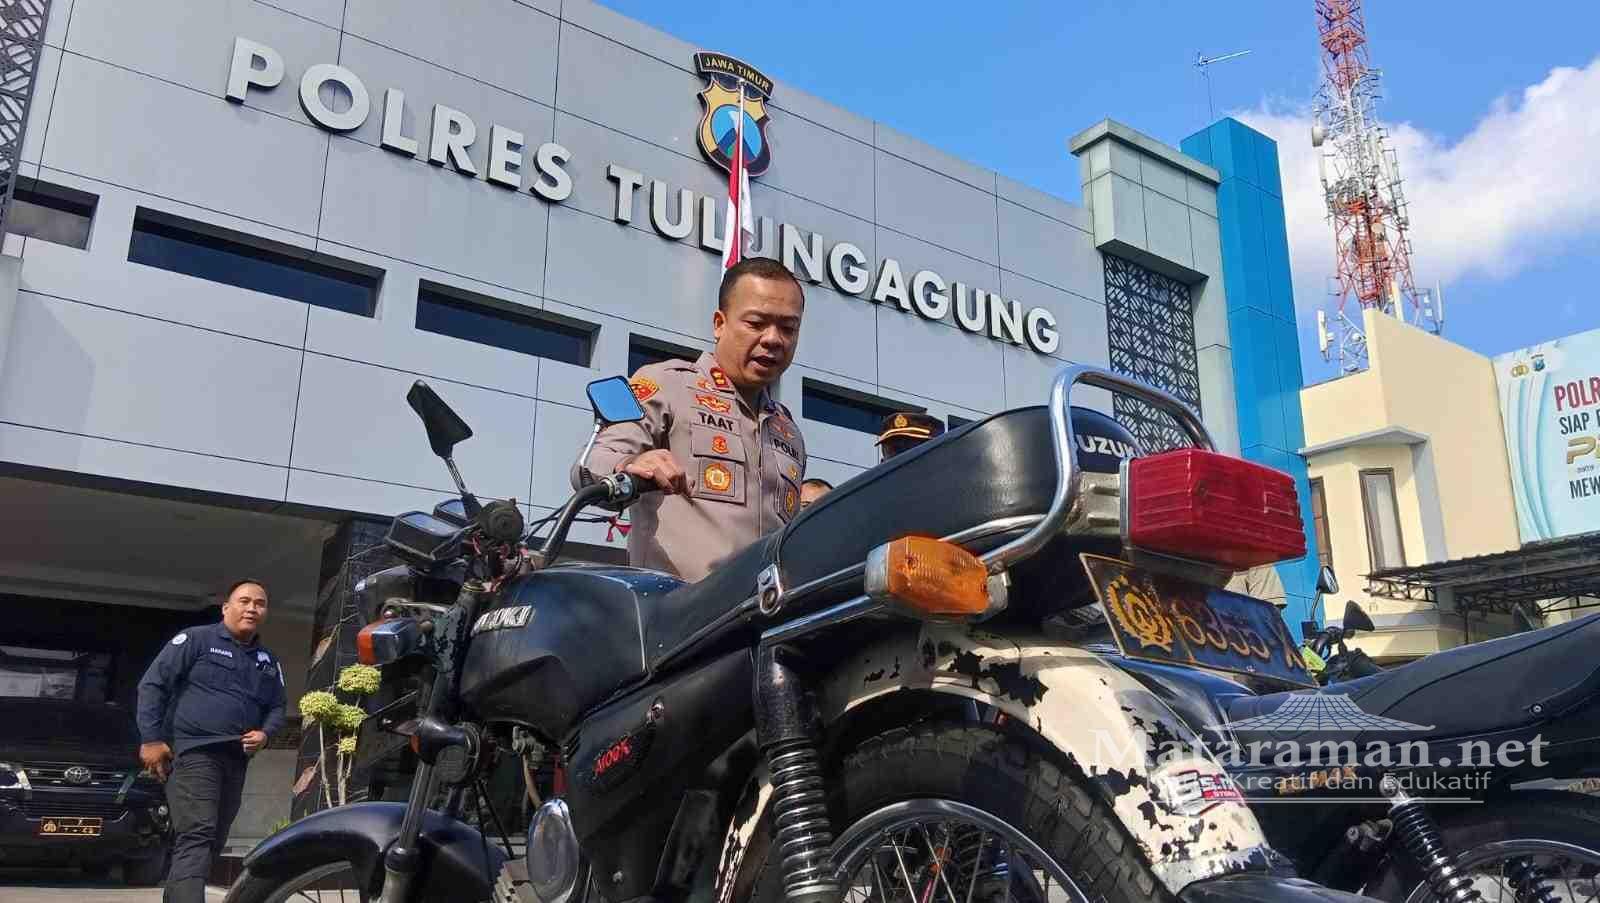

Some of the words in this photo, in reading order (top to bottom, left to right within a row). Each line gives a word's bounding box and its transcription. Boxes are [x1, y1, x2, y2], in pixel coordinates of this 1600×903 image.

[704, 56, 735, 72] JAWA
[737, 65, 769, 92] TIMUR
[225, 36, 574, 202] POLRES
[606, 163, 1062, 356] TULUNGAGUNG
[697, 411, 734, 432] TAAT
[1559, 412, 1590, 435] SIAP
